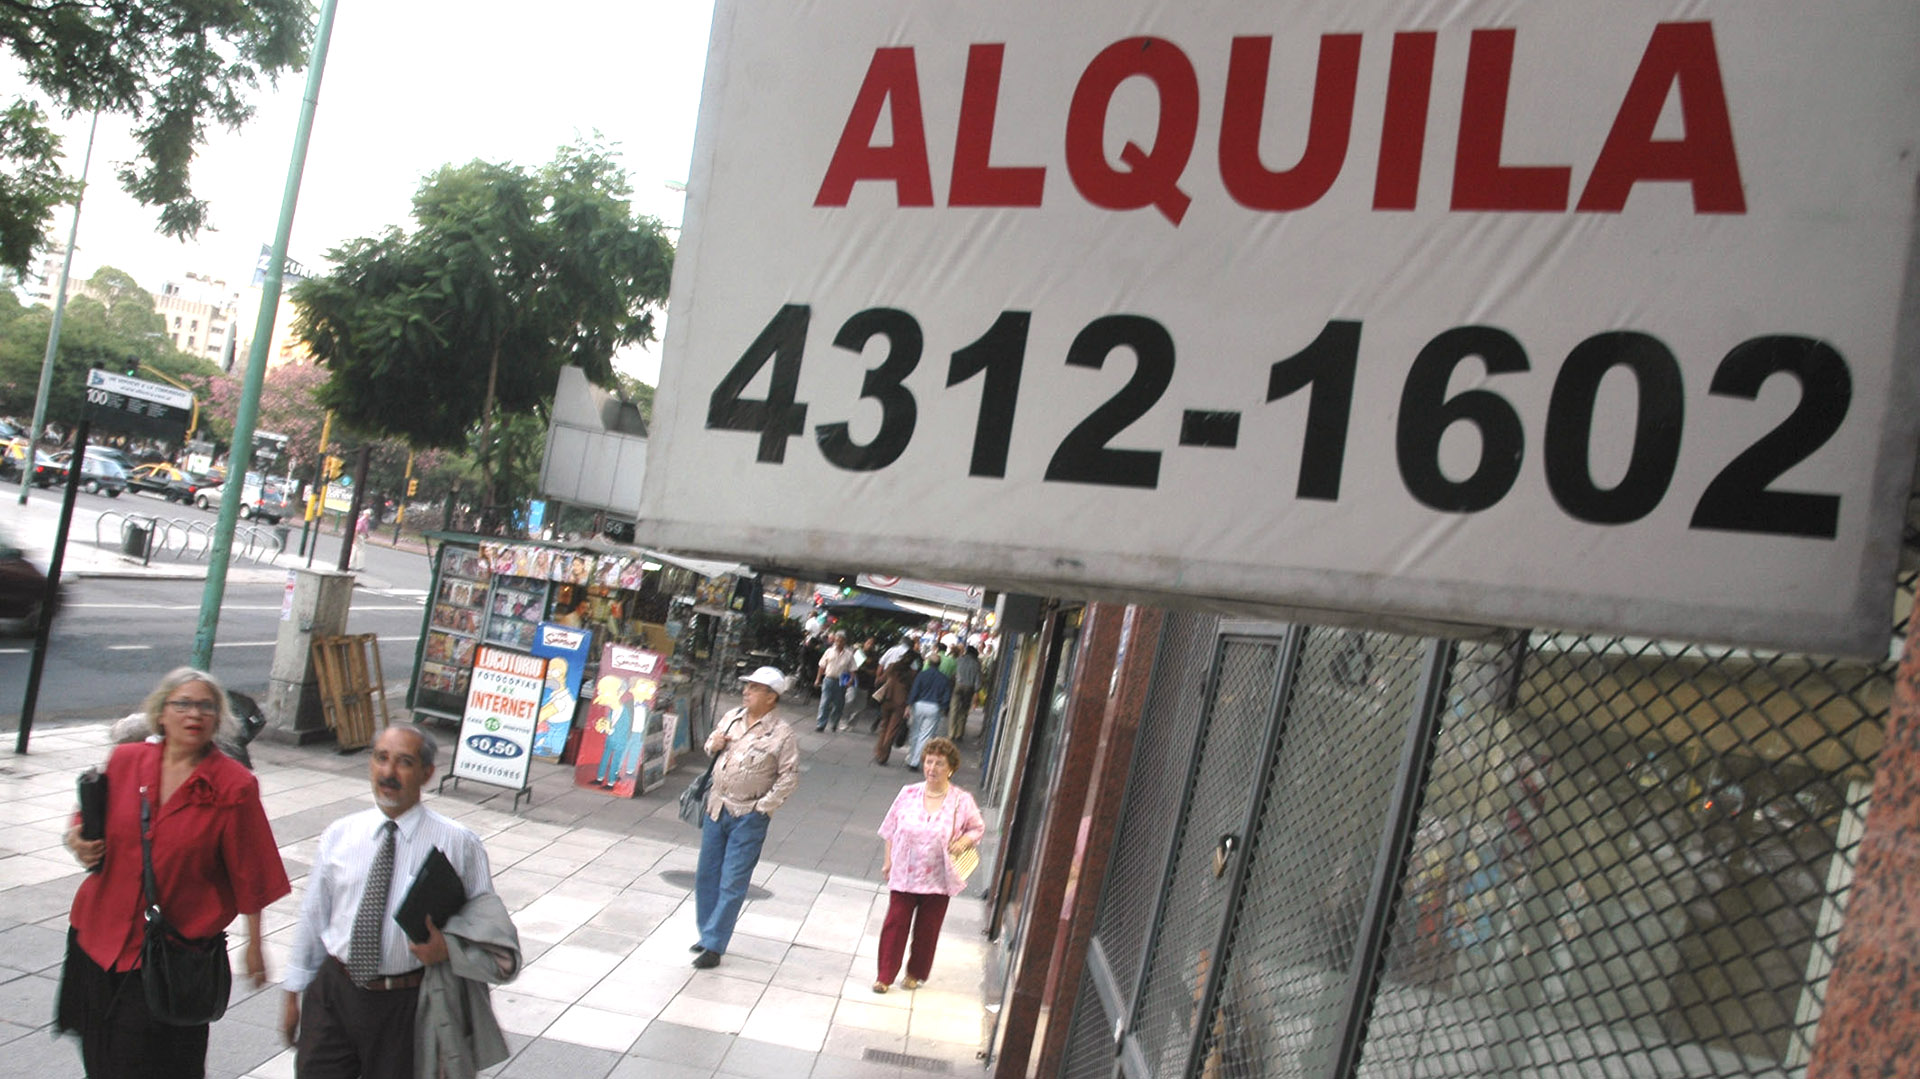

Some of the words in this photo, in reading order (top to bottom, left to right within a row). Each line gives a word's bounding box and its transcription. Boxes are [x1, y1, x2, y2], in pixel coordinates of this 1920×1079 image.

[816, 22, 1746, 226] ALQUILA
[87, 388, 109, 405] 100
[707, 304, 1853, 541] 4312-1602
[478, 646, 544, 679] LOCUTORIO
[477, 671, 538, 690] FOTOCOPIAS
[496, 685, 515, 695] FAX
[470, 691, 535, 719] INTERNET
[471, 737, 517, 756] $0,50
[460, 761, 521, 780] IMPRESIONES
